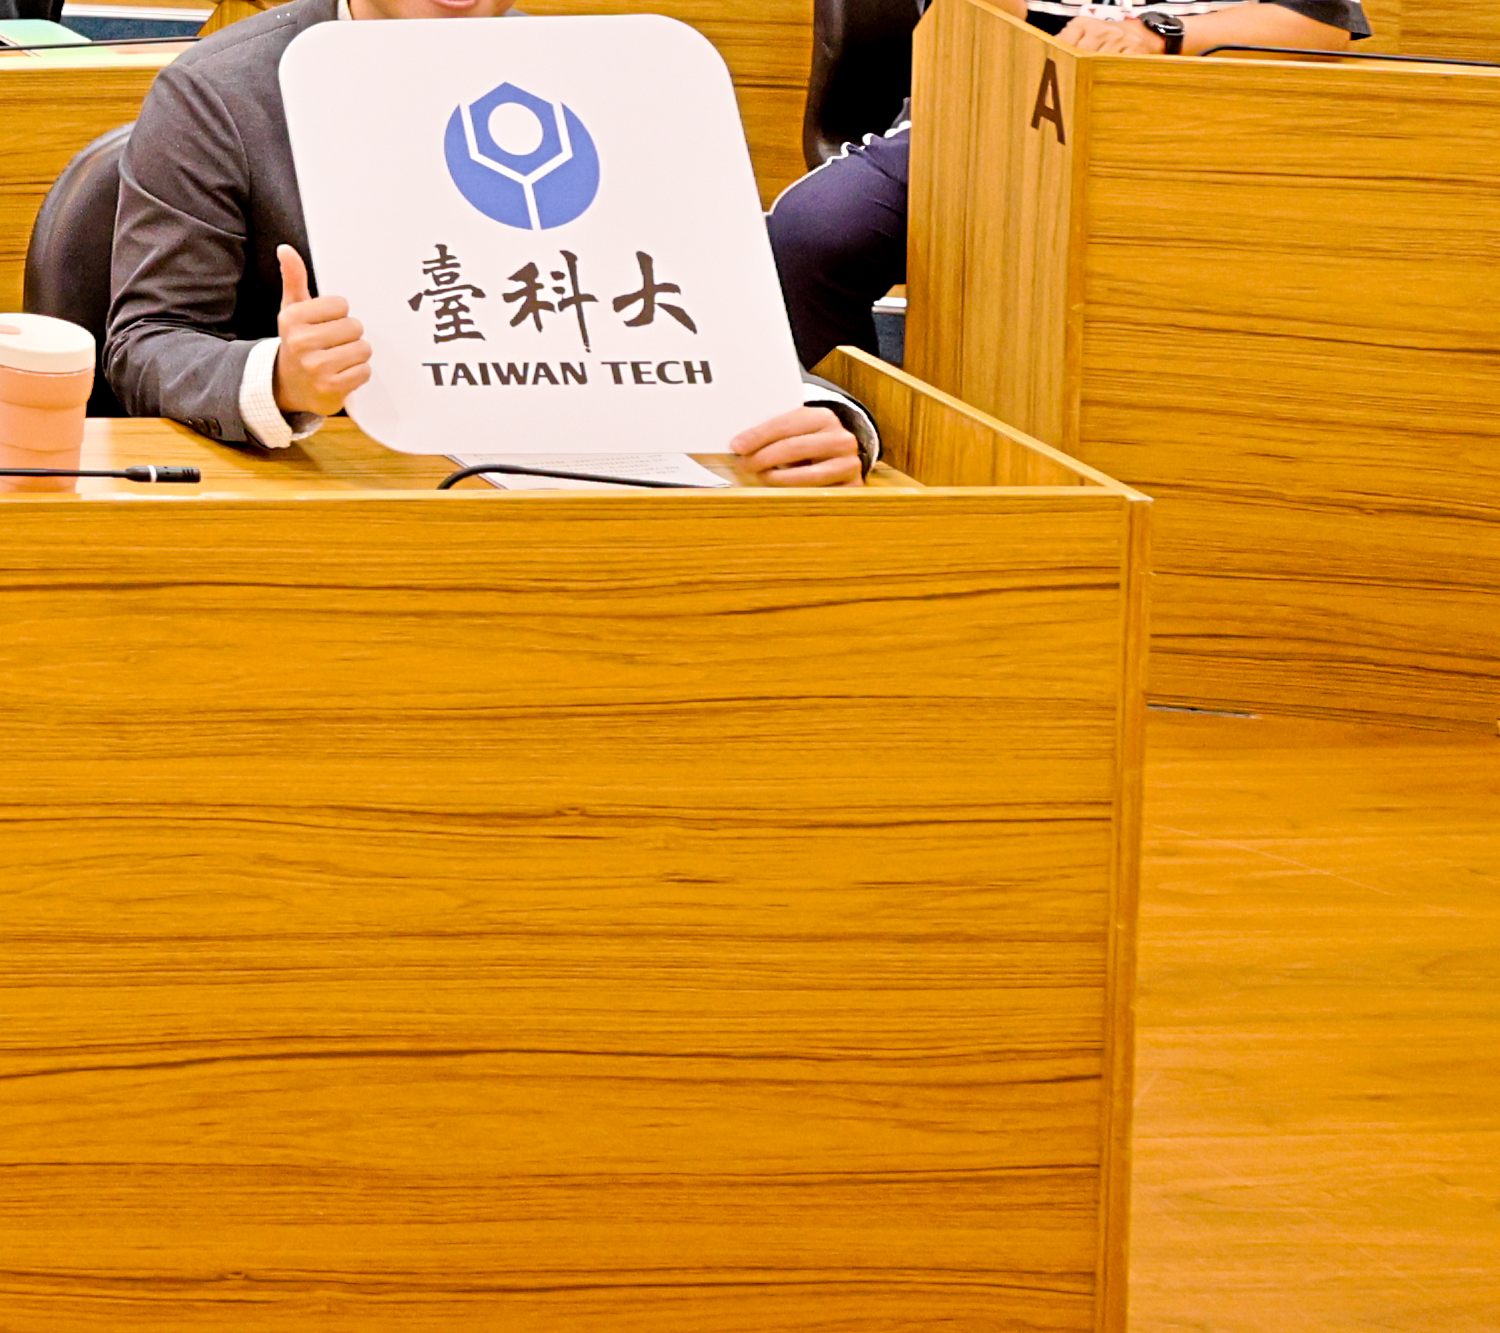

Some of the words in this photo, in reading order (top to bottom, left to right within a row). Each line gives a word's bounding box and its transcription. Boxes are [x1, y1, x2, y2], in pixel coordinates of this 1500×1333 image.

[1030, 57, 1067, 146] A
[406, 242, 700, 353] 臺科大
[423, 360, 588, 387] TAIWAN
[601, 359, 713, 386] TECH
